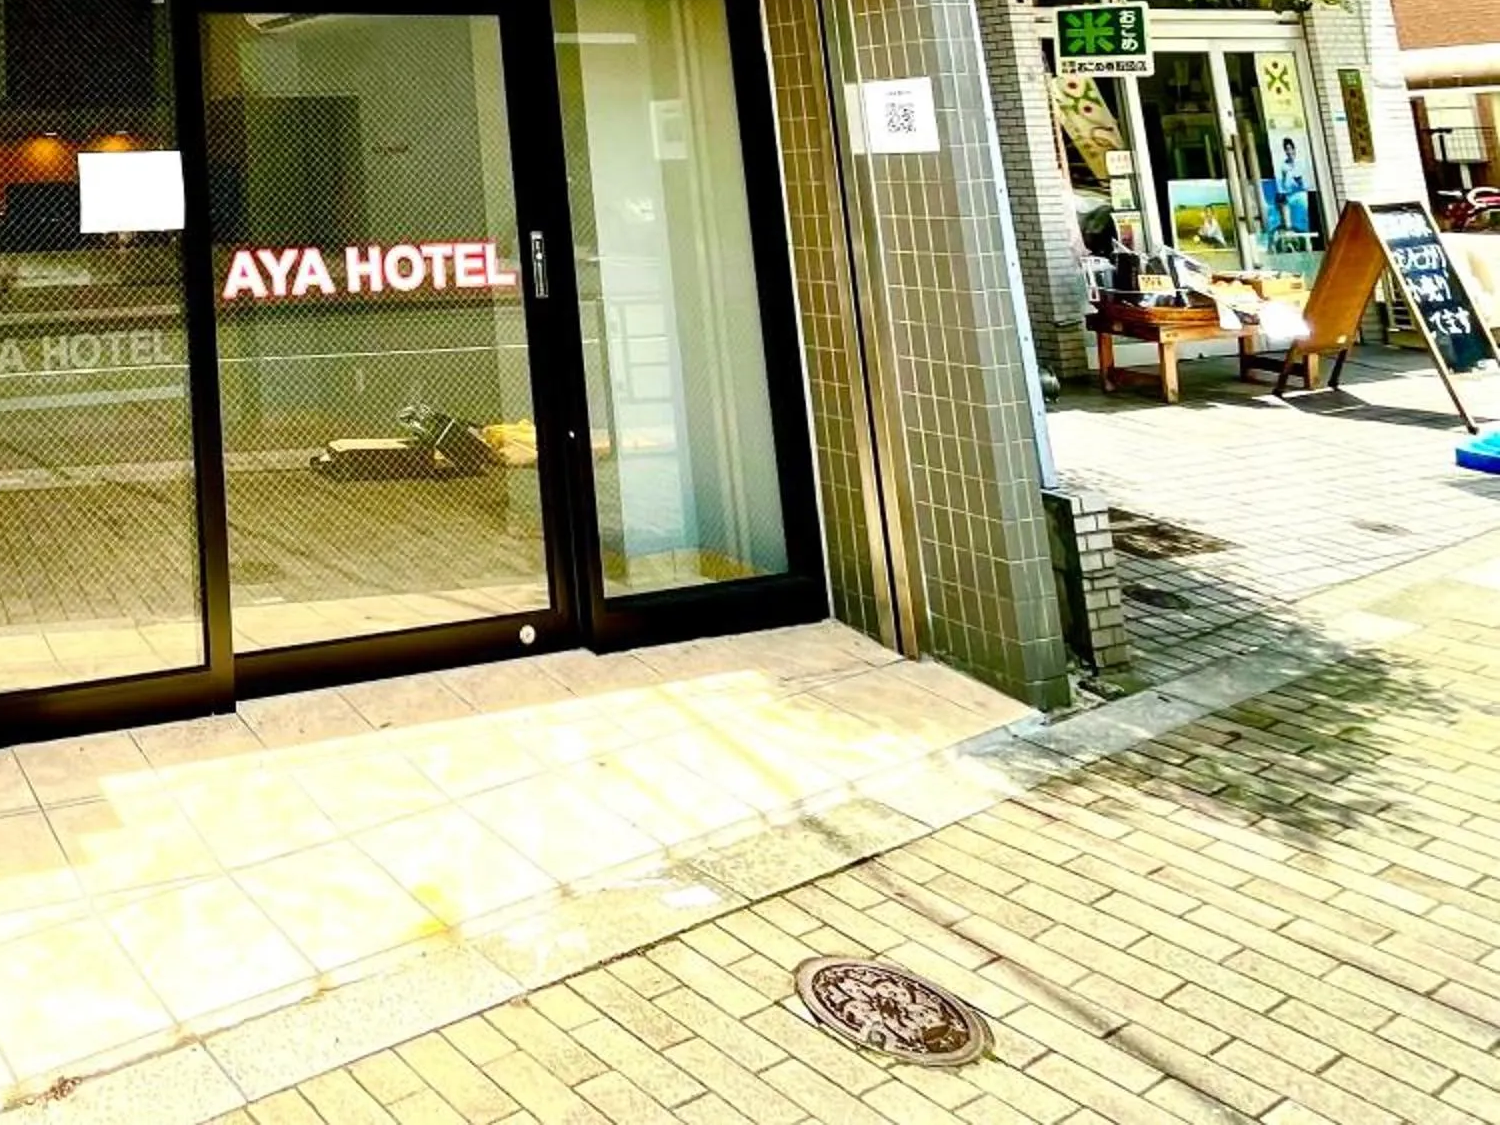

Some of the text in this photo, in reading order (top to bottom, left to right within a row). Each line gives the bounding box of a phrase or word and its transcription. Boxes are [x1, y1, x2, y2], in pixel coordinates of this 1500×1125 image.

[1118, 10, 1139, 52] おこめ
[223, 242, 517, 300] AYA HOTEL
[43, 329, 174, 372] HOTEL
